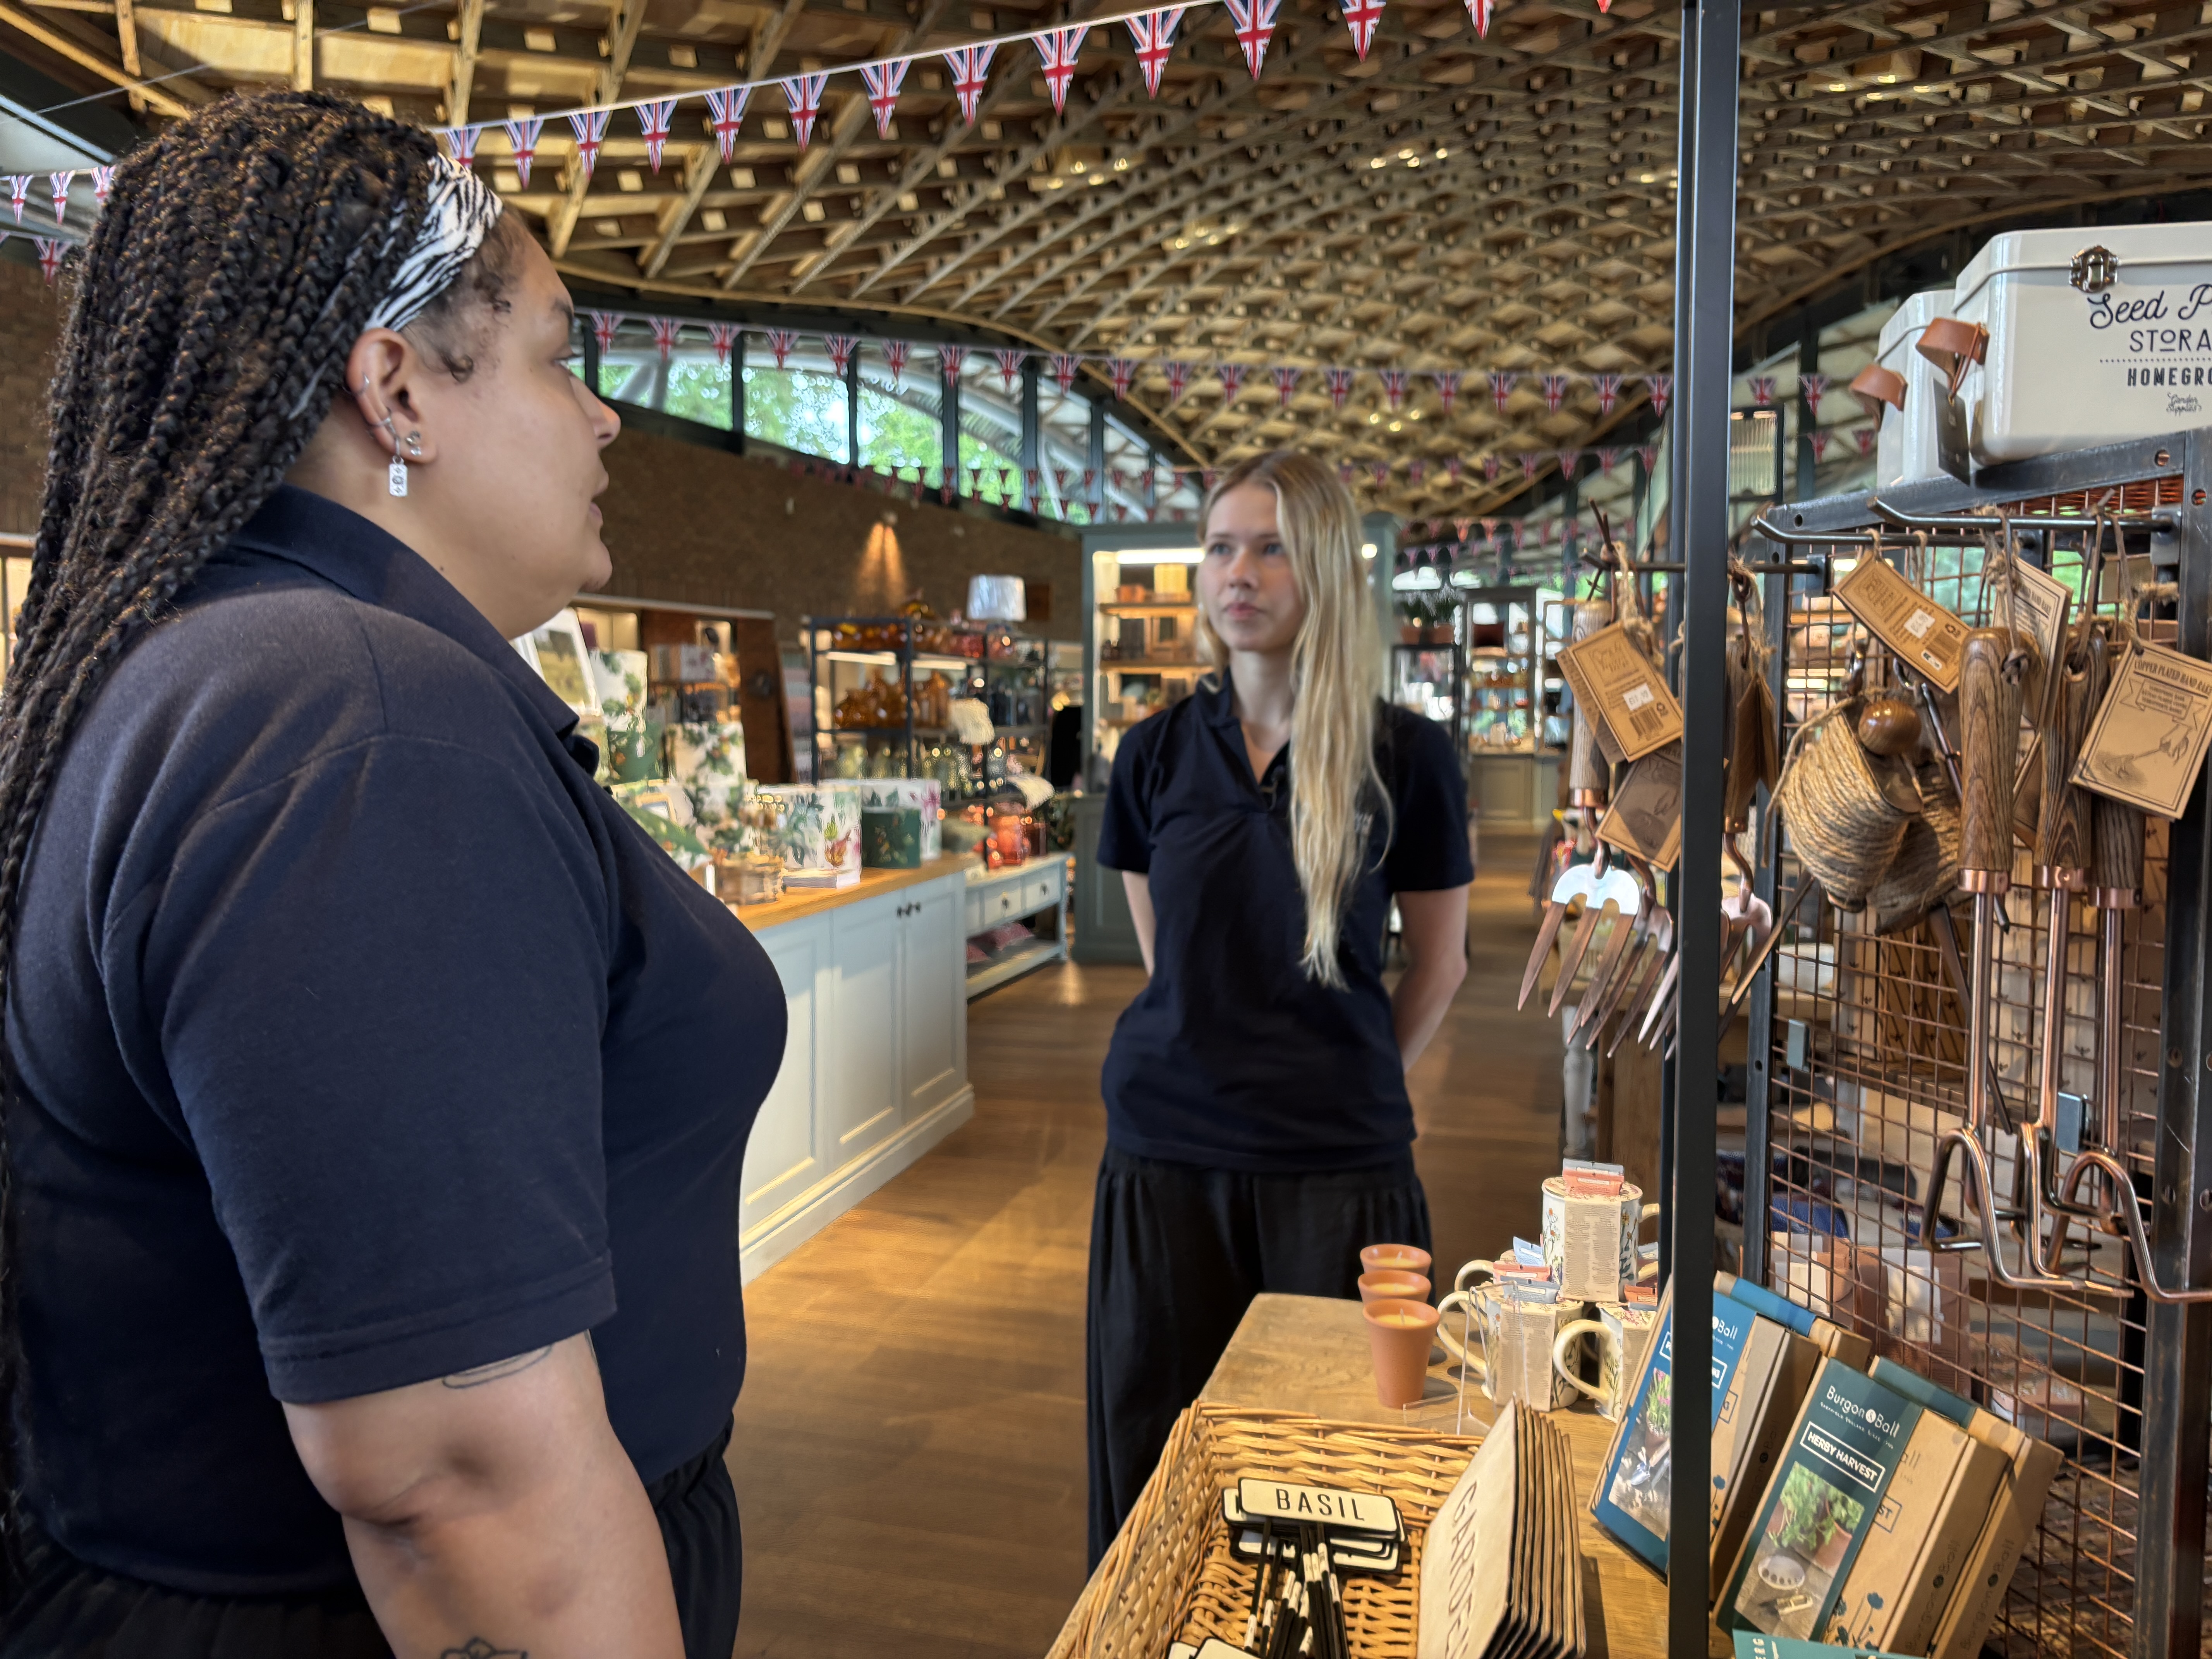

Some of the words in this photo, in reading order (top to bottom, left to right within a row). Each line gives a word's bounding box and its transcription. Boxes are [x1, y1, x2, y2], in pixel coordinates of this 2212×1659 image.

[2087, 290, 2168, 330] Seed
[2178, 283, 2212, 320] P
[1807, 1431, 1837, 1456] HERBY
[1836, 1449, 1878, 1481] HARVEST
[1275, 1488, 1365, 1521] BASIL
